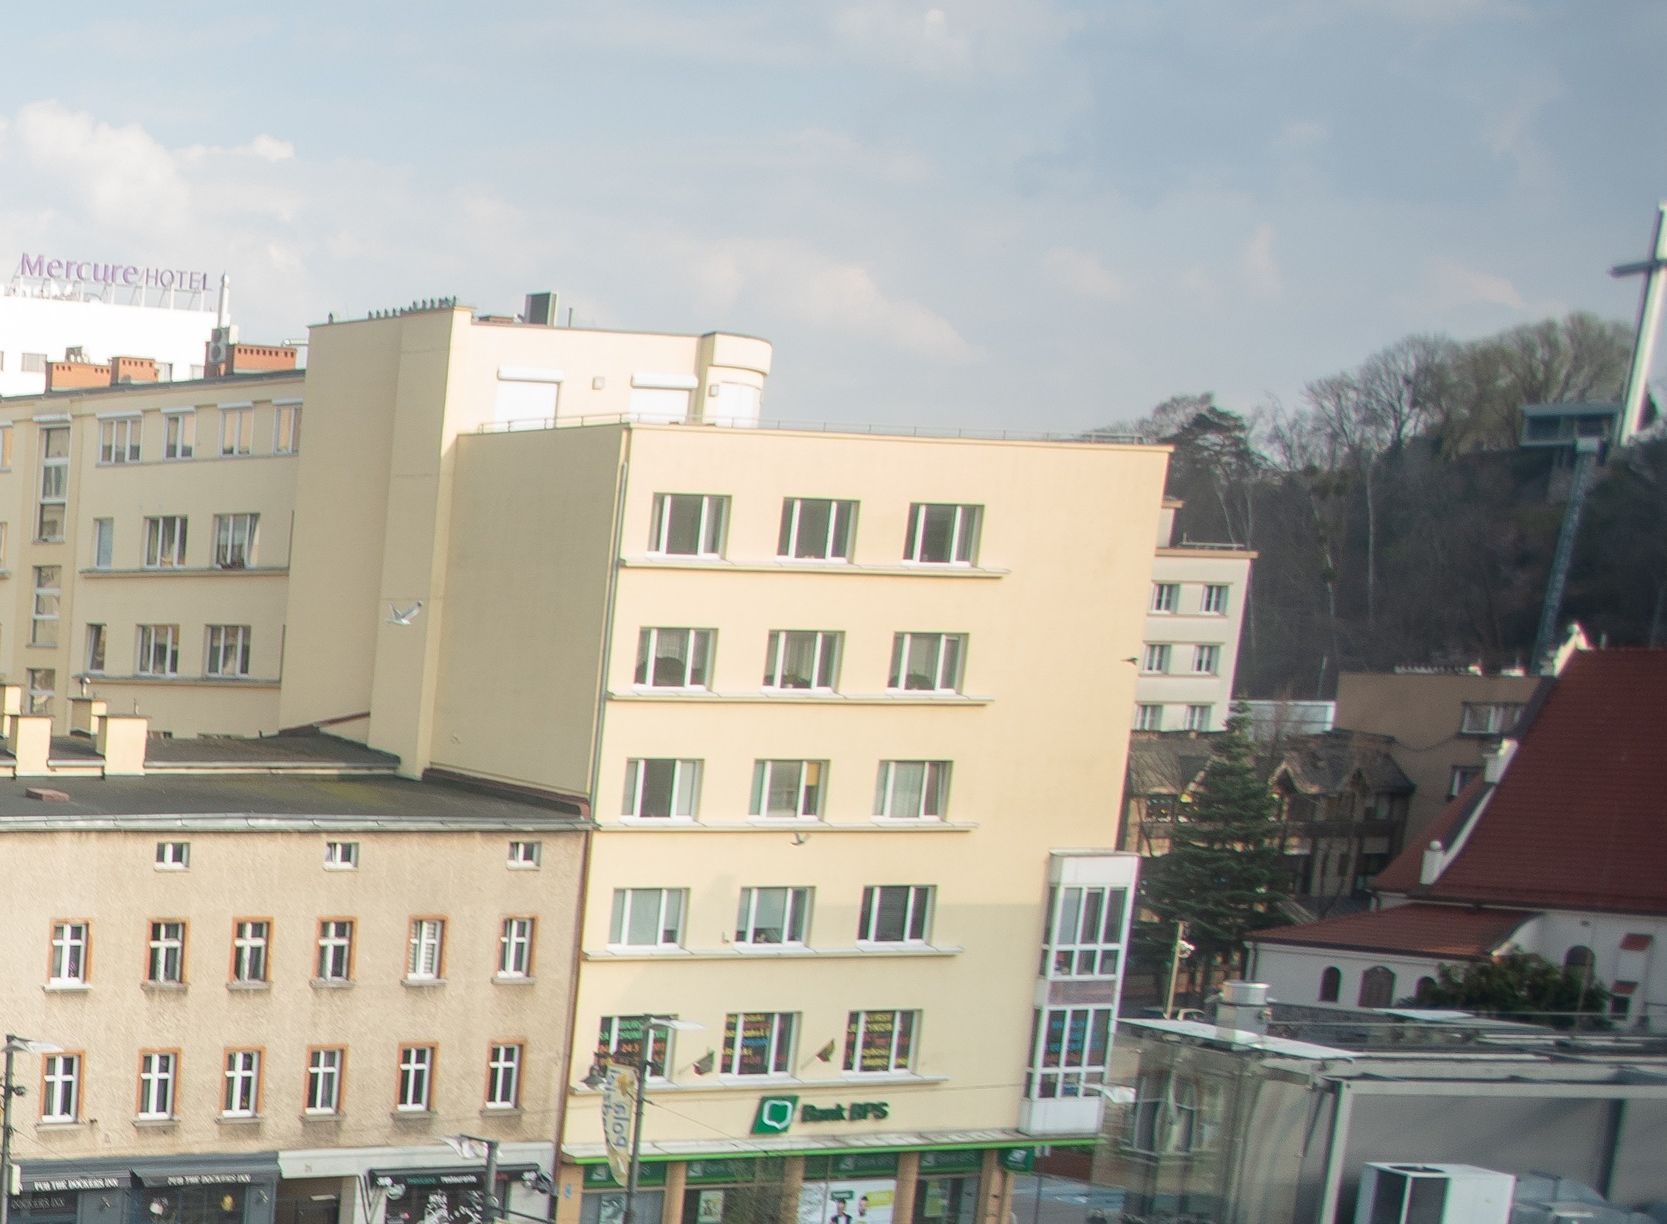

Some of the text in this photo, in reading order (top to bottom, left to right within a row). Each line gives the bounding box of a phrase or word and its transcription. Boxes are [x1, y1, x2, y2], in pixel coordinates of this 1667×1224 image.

[20, 252, 213, 291] Mercure HOTEL
[801, 1102, 889, 1121] Bank BPS
[34, 1180, 51, 1191] PUB
[51, 1179, 68, 1190] THE
[68, 1178, 105, 1189] DOCKERS
[105, 1177, 119, 1188] INN
